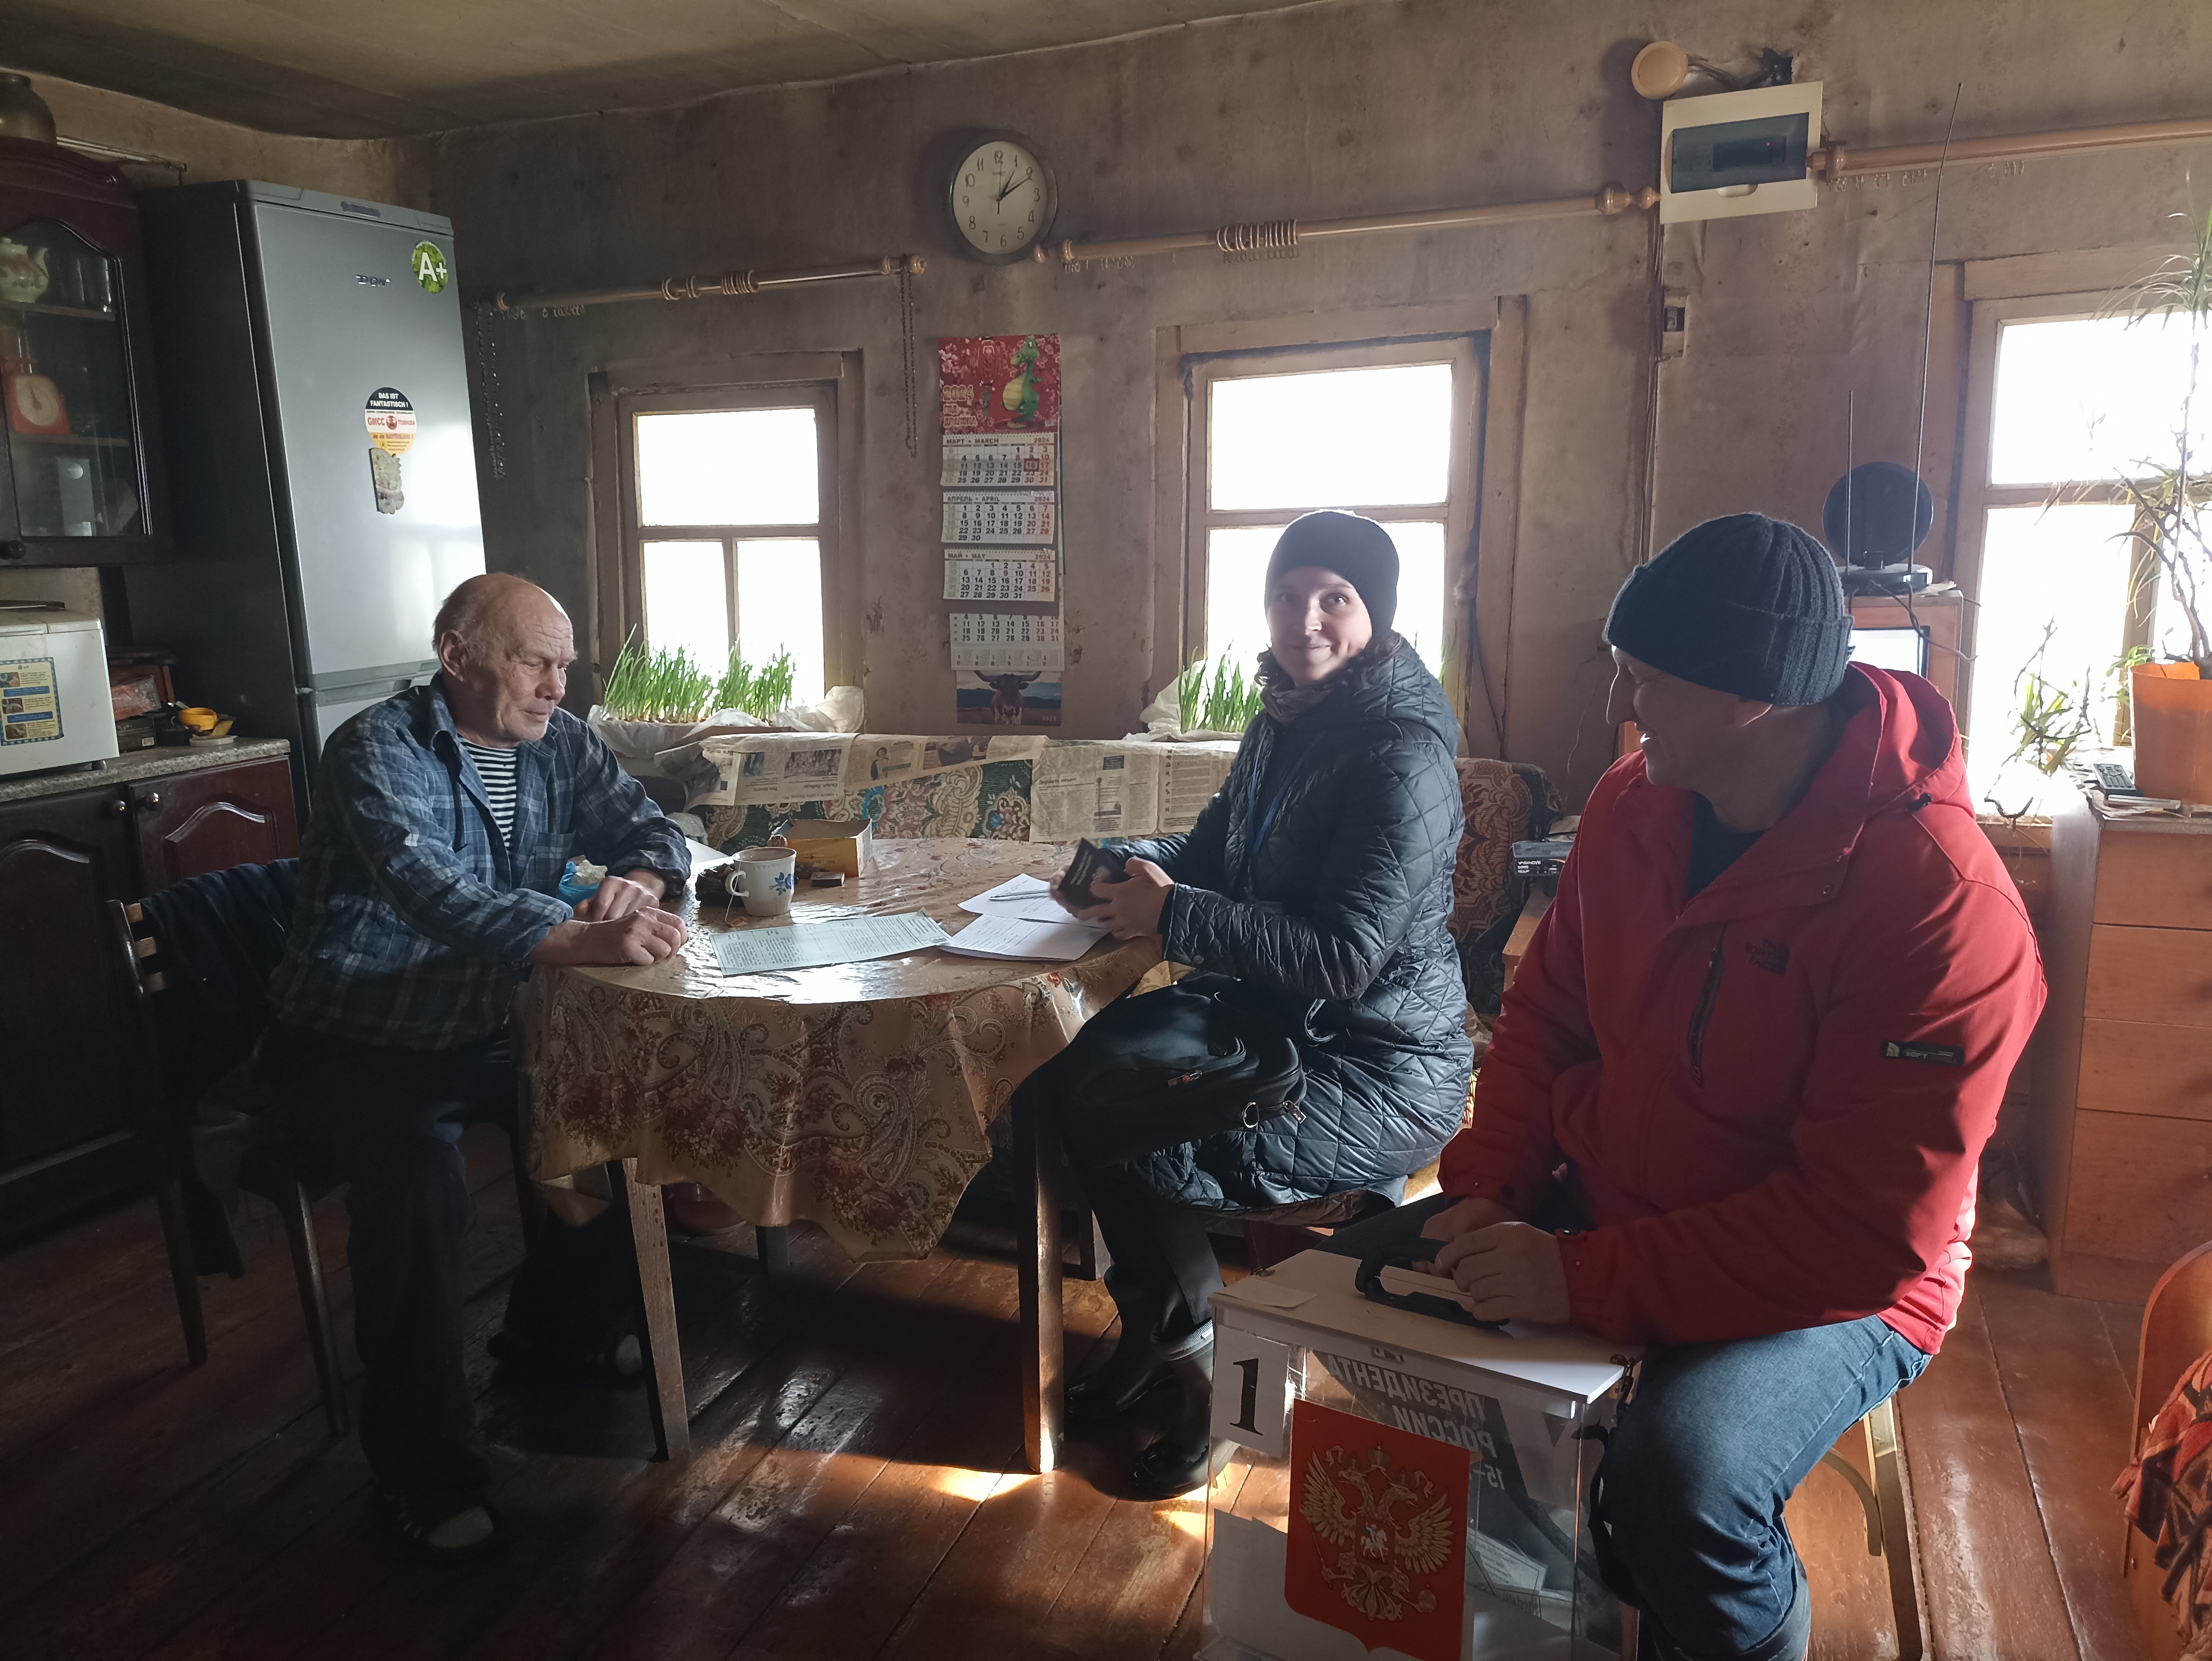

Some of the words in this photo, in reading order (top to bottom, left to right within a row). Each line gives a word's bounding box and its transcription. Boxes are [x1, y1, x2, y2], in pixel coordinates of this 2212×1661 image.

[994, 150, 1003, 164] 12
[1014, 155, 1018, 167] 1
[977, 158, 984, 171] 11
[965, 173, 975, 188] 10
[1026, 167, 1033, 180] 2
[962, 195, 969, 208] 9
[1034, 188, 1040, 202] 3
[969, 215, 976, 230] 8
[1029, 210, 1034, 223] 4
[983, 230, 988, 243] 7
[1017, 226, 1024, 240] 5
[1000, 234, 1006, 247] 6
[419, 253, 447, 281] A+
[943, 385, 974, 401] 2024
[1229, 1358, 1263, 1436] 1
